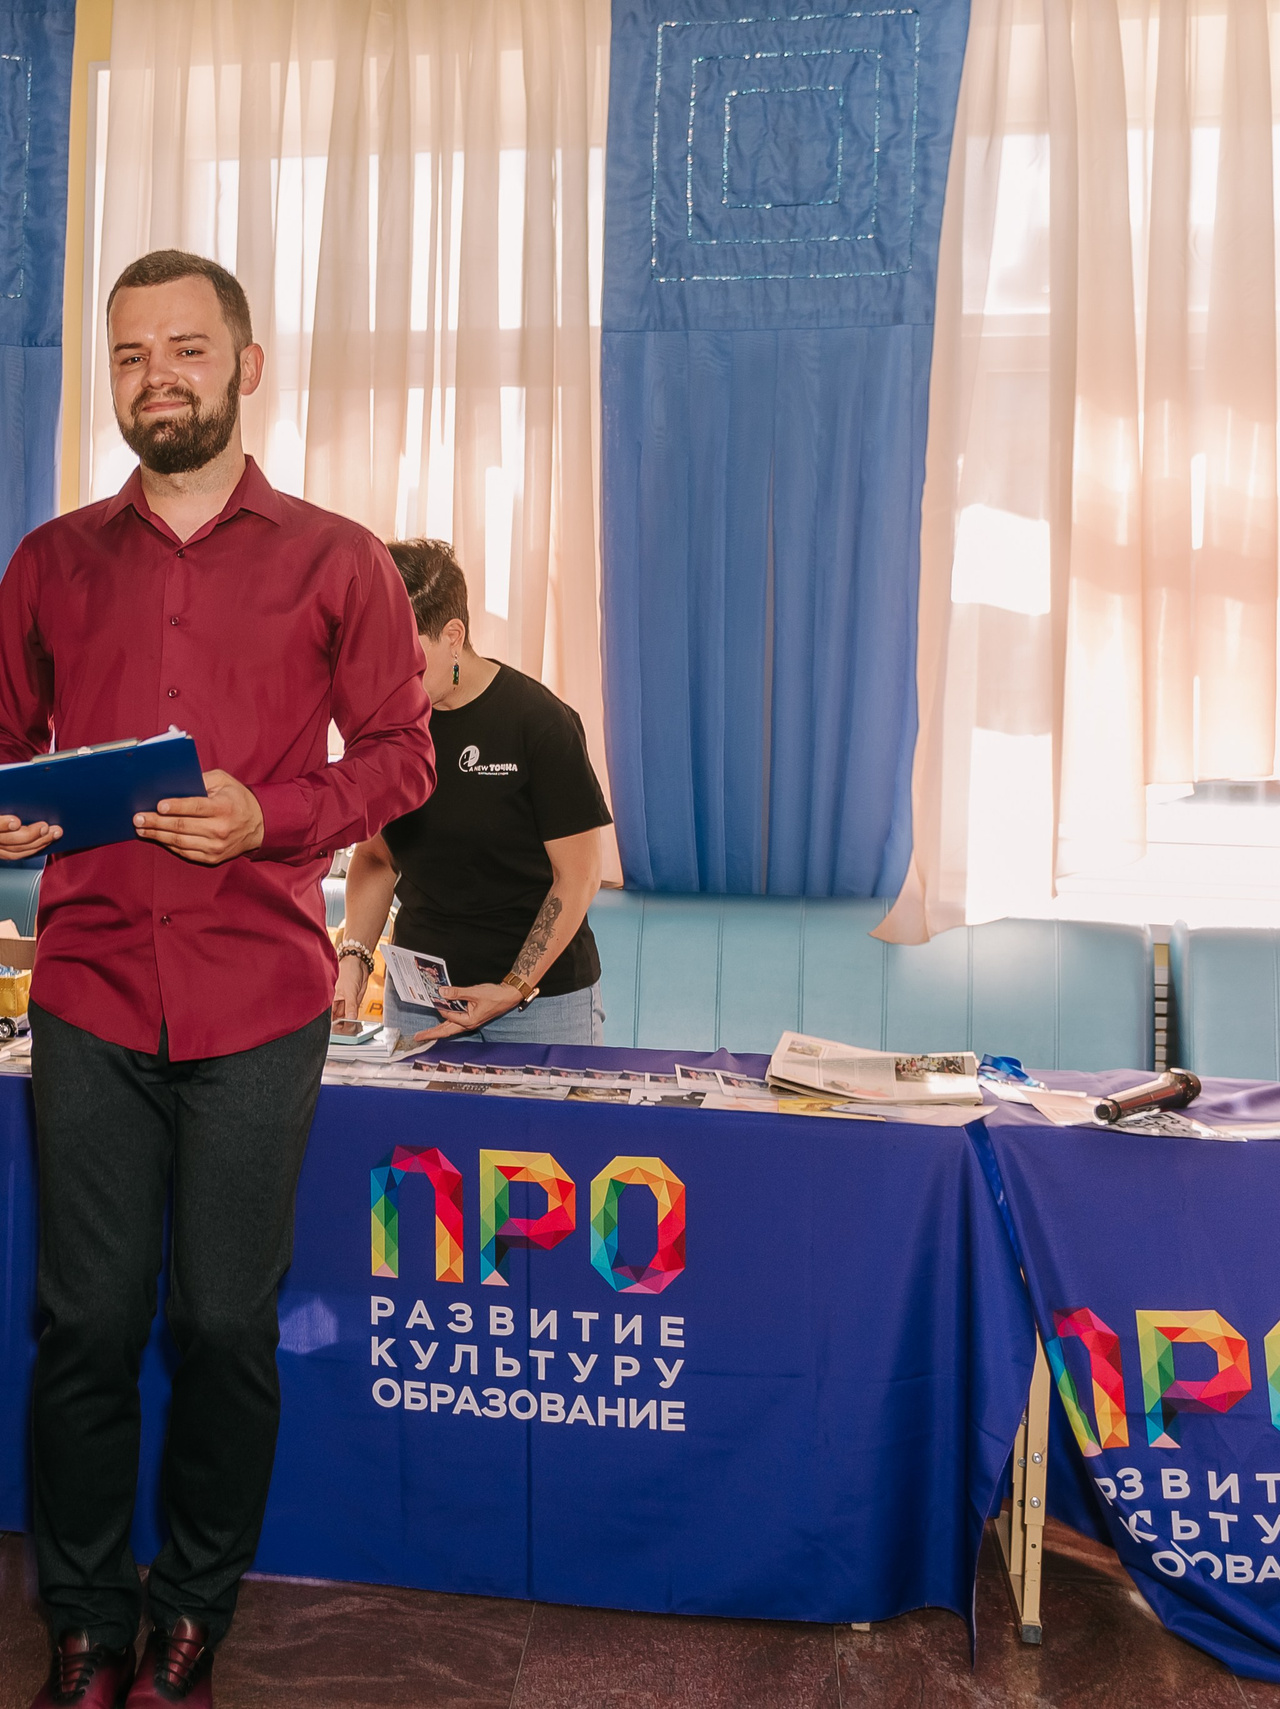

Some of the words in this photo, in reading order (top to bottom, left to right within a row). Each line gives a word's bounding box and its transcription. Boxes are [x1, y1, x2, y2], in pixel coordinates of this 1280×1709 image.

[370, 1144, 686, 1294] ПРО
[370, 1295, 686, 1348] РАЗВИТИЕ
[370, 1335, 685, 1389] КУЛЬТУРУ
[1045, 1306, 1280, 1458] ПР
[371, 1377, 686, 1431] ОБРАЗОВАНИЕ
